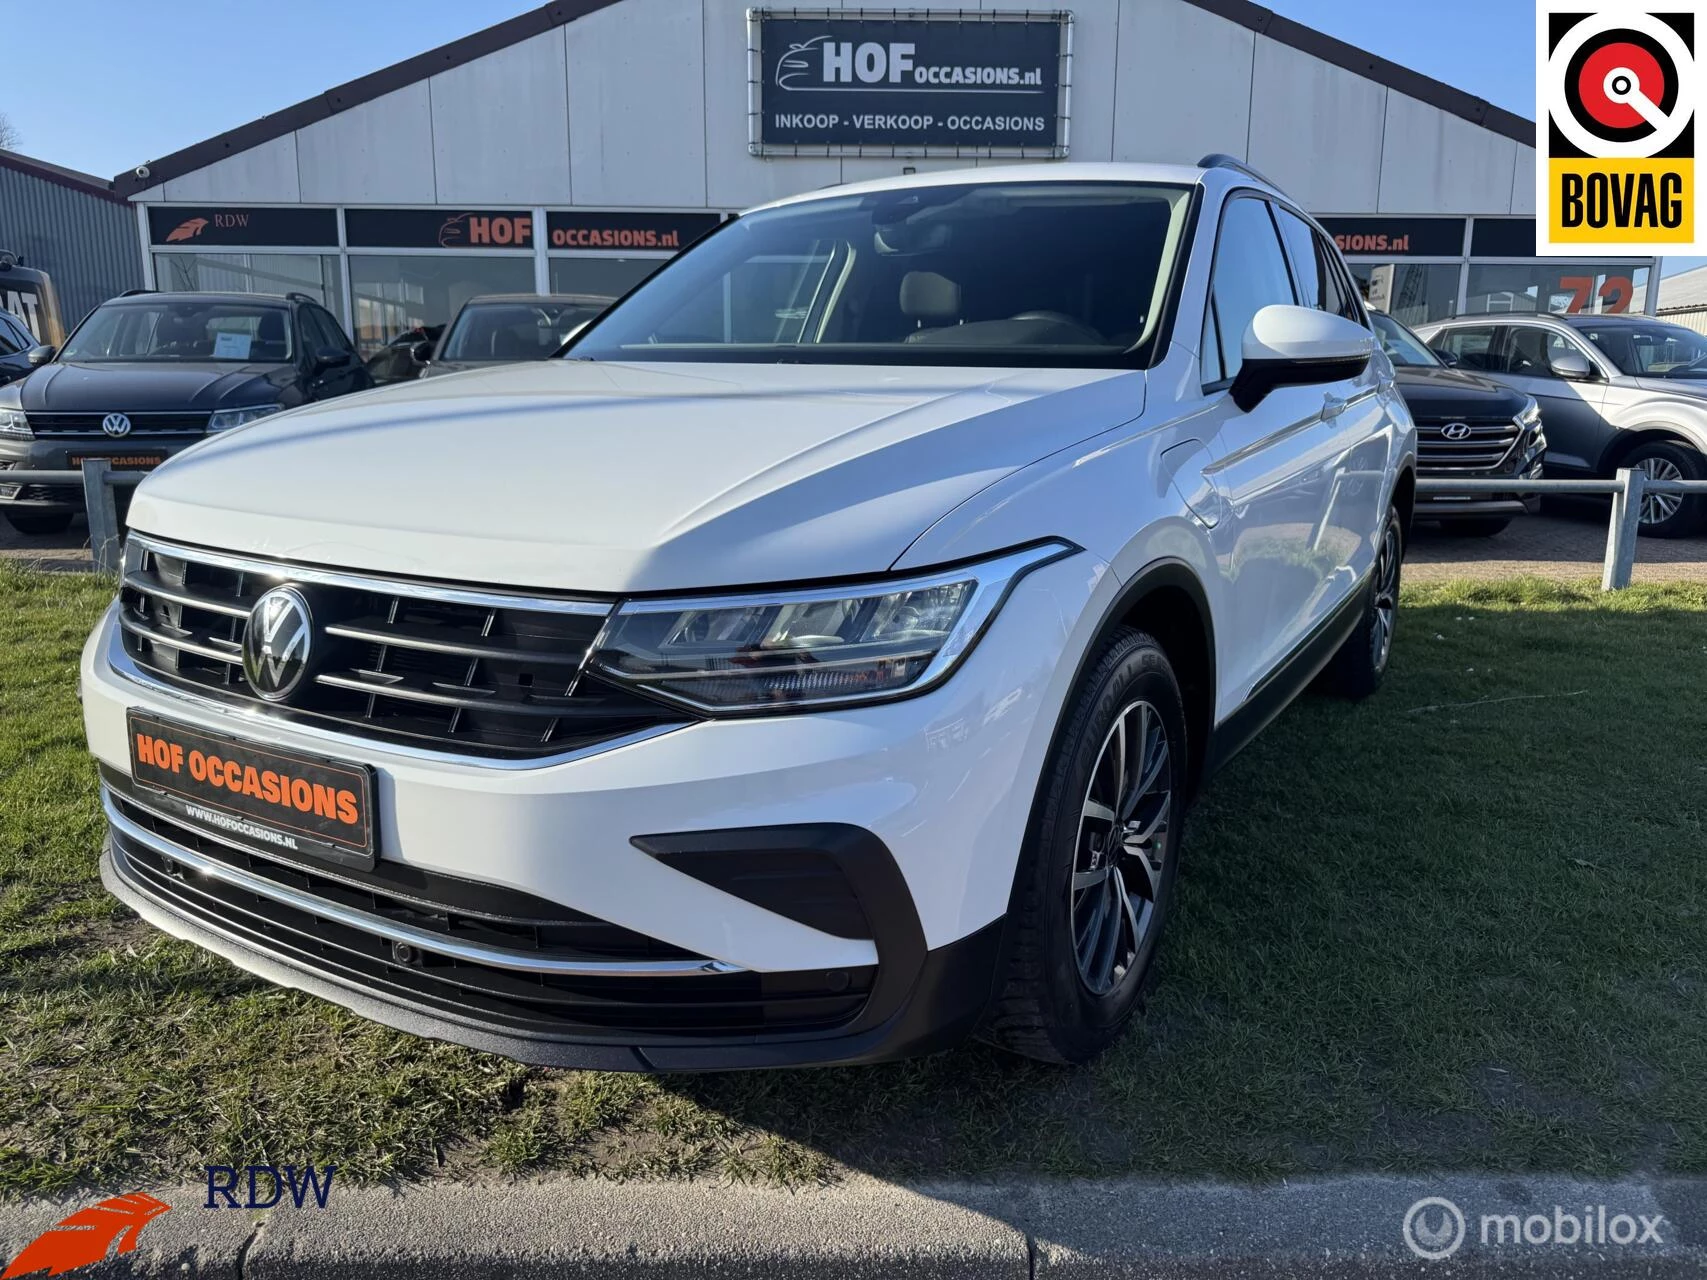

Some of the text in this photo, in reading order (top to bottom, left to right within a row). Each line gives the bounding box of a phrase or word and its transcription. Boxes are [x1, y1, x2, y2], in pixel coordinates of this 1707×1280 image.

[822, 42, 1042, 85] HOF OCCASIONS.nl
[775, 114, 839, 129] INKOOP
[853, 115, 933, 130] VERKOOP
[947, 116, 1045, 132] OCCASIONS
[214, 214, 249, 228] RDW
[469, 217, 679, 247] HOF OCCASIONS.nl
[1334, 234, 1409, 251] SIONS.nl
[0, 290, 41, 343] AT
[111, 456, 160, 465] CASIONS
[136, 733, 359, 825] HOF OCCASIONS
[185, 804, 299, 850] WWW.HOFOCCASIONS.NL
